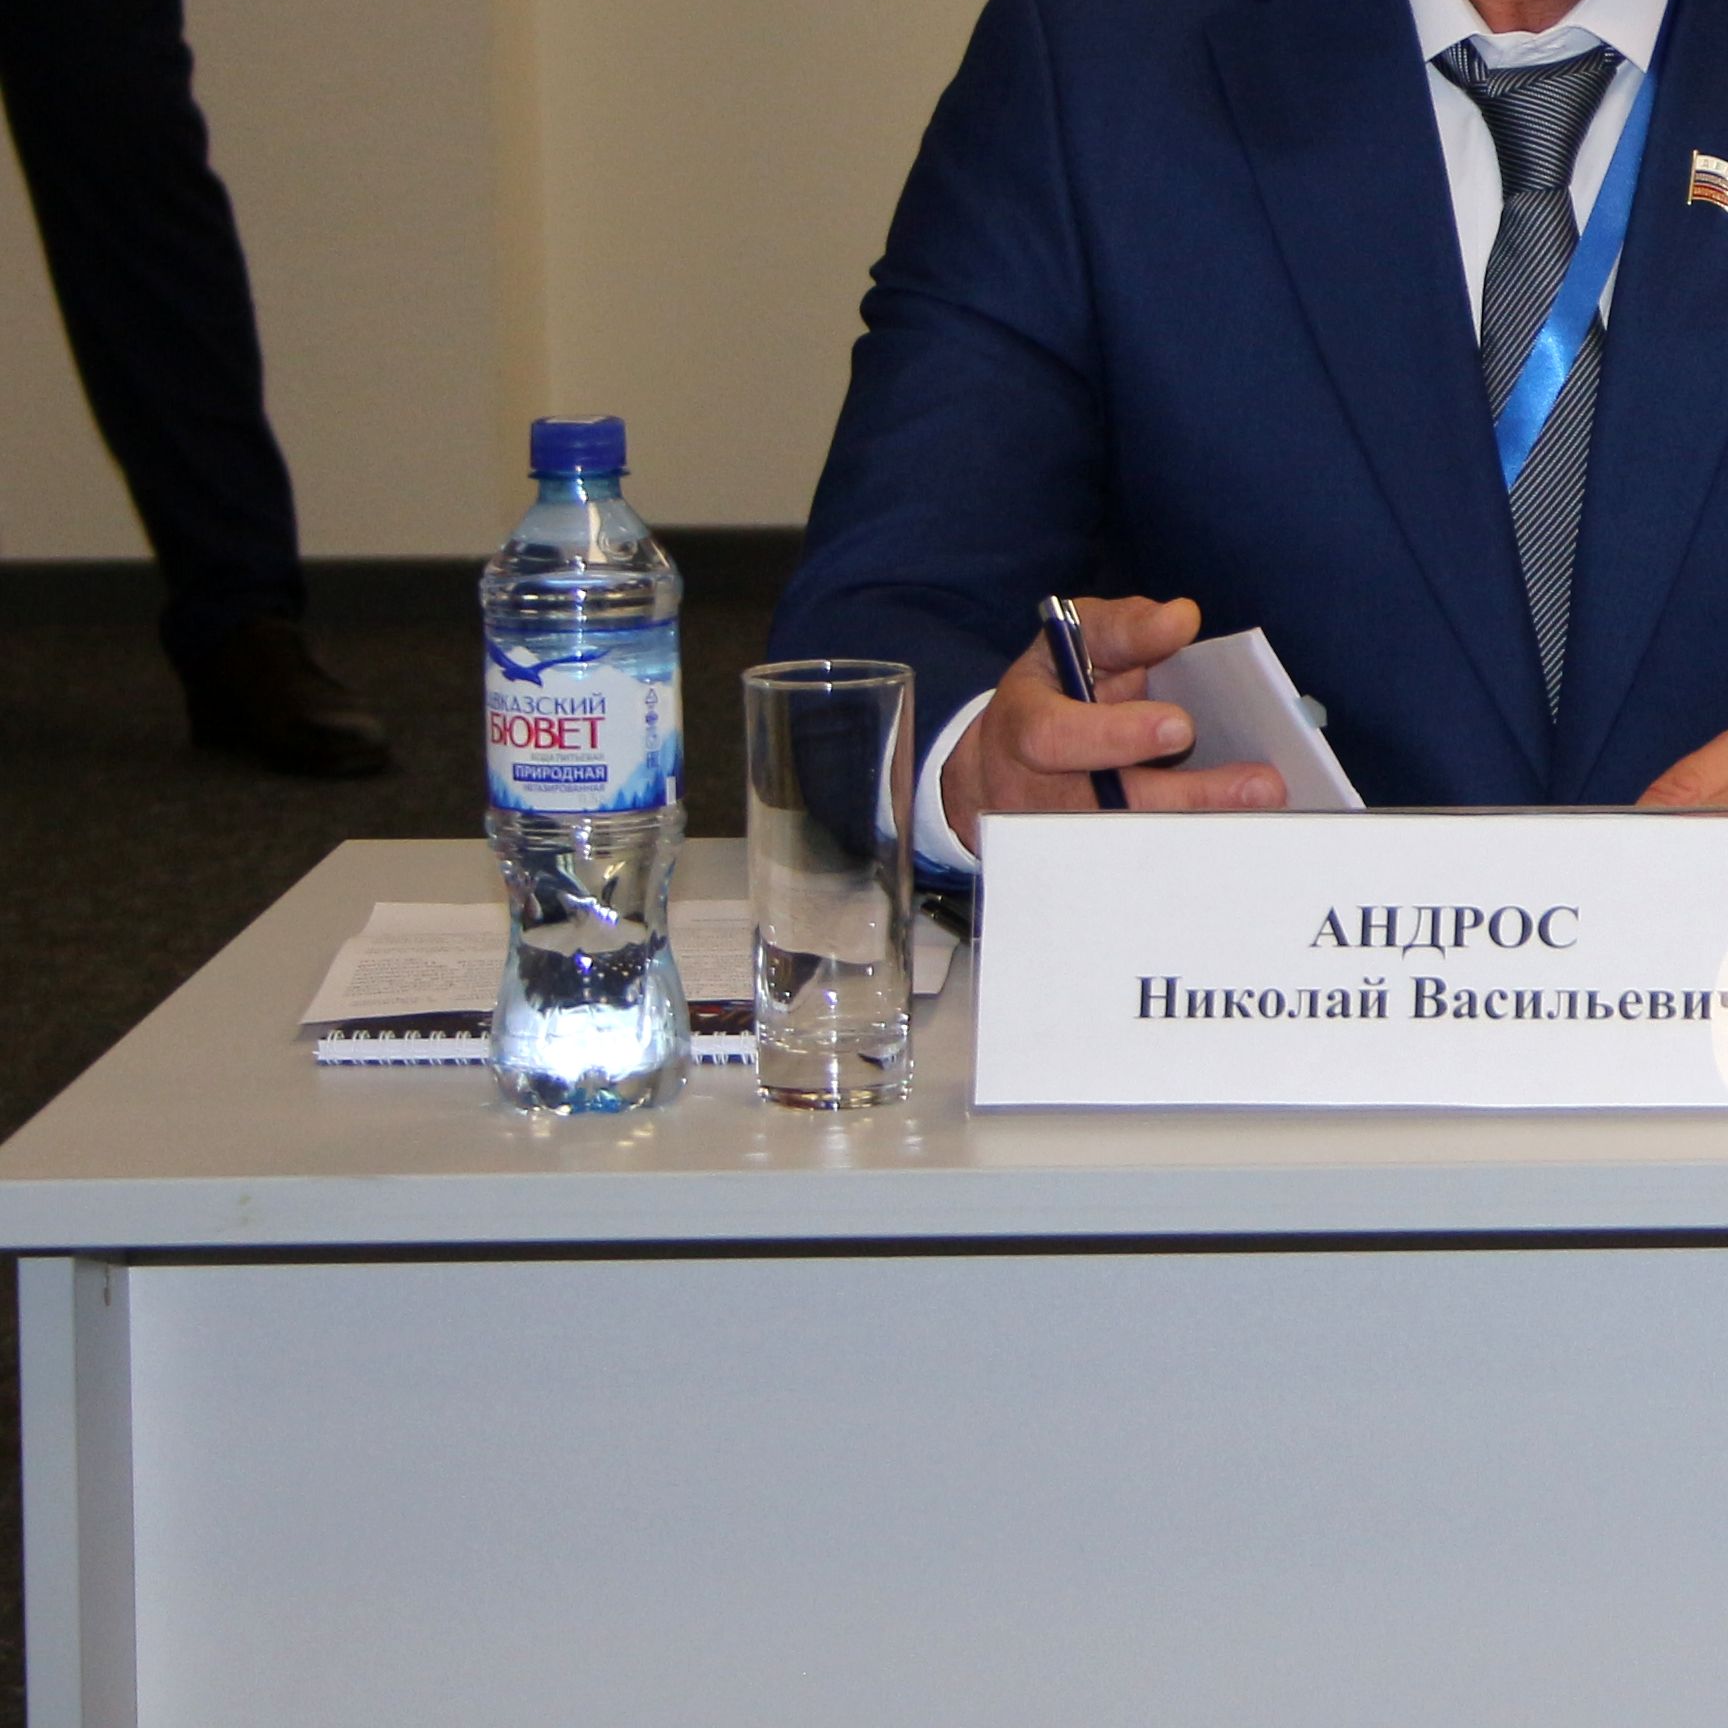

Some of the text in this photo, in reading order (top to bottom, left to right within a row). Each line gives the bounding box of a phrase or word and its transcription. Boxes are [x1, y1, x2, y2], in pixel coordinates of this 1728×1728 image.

[490, 711, 606, 749] БЮВЕТ
[514, 764, 606, 782] ПРИРОДНАЯ
[1308, 905, 1581, 958] АНДРОС
[1136, 975, 1389, 1020] Николай
